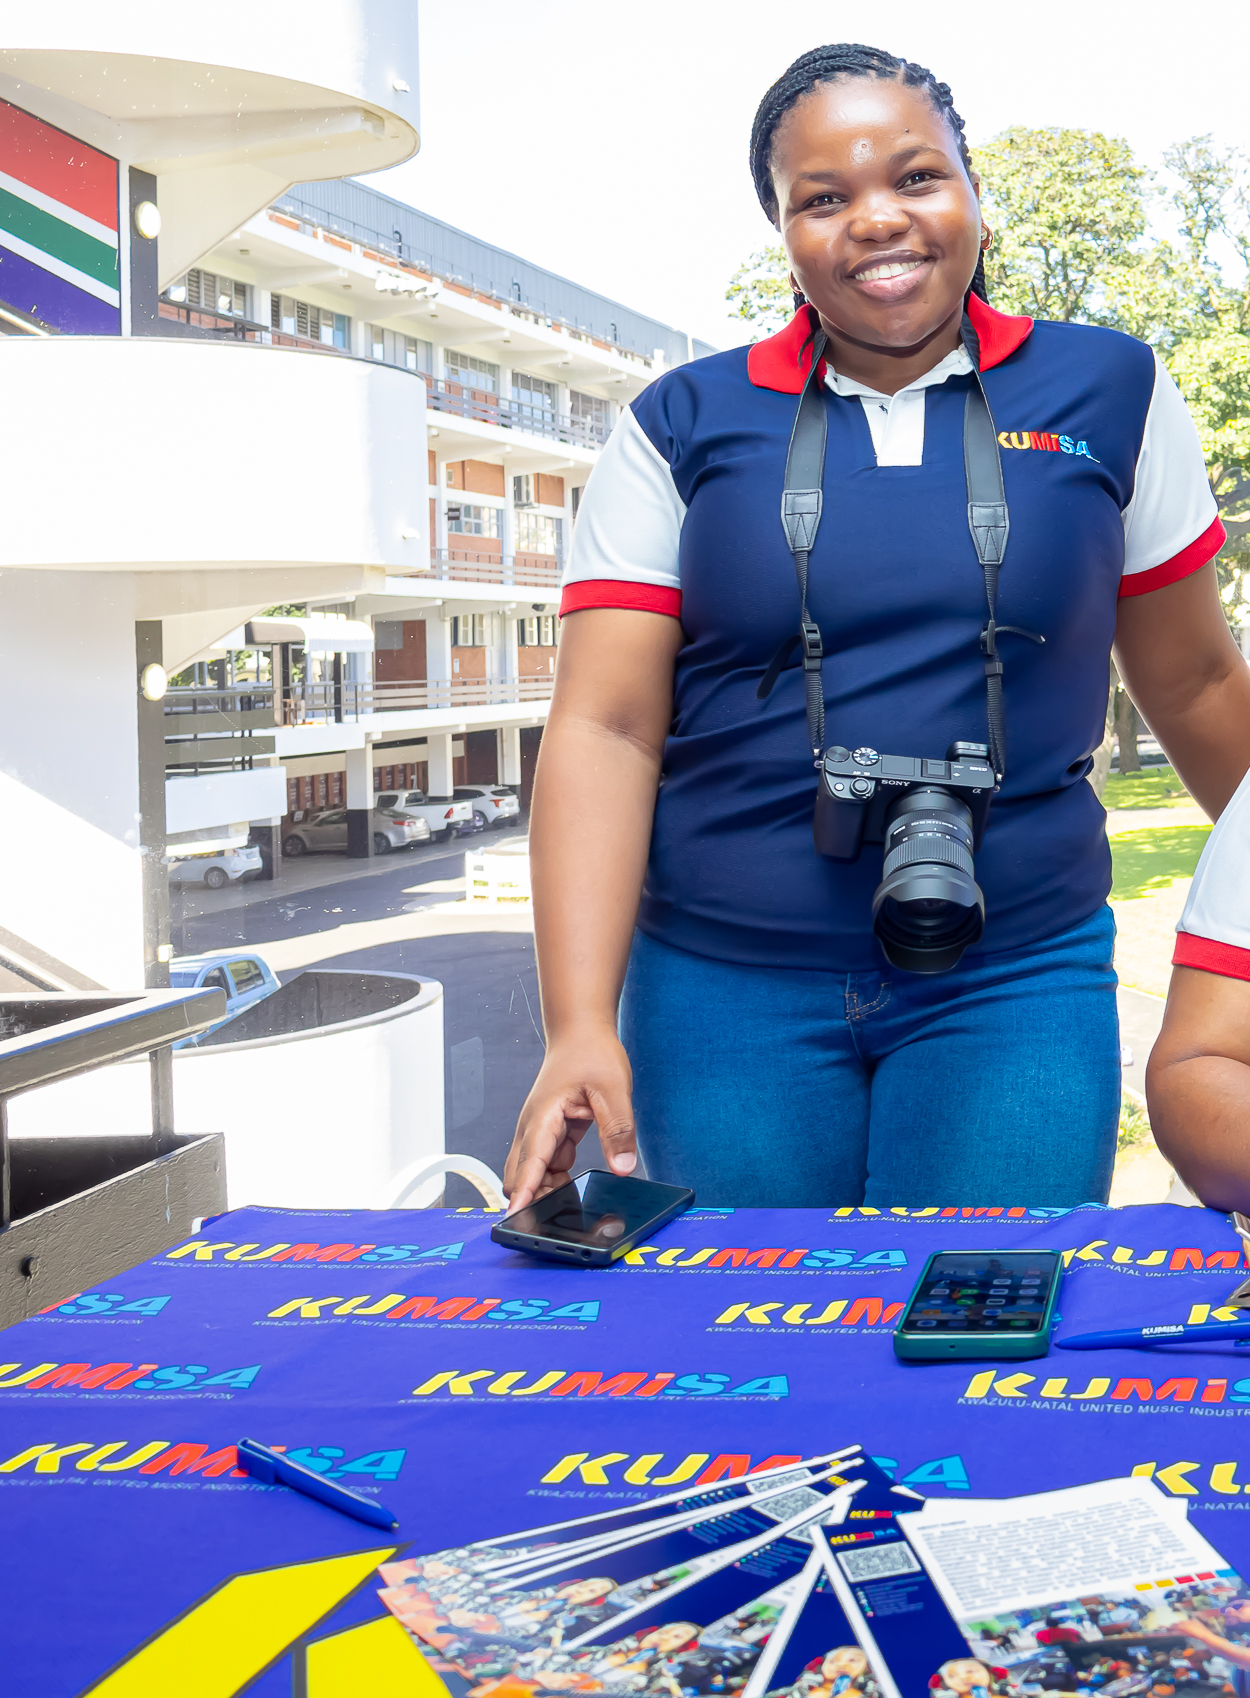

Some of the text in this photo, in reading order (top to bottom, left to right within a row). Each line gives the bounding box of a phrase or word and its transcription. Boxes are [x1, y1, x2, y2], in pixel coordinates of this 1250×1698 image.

[881, 779, 910, 787] SONY
[677, 1214, 728, 1222] OCIATION
[827, 1216, 914, 1225] KWAZULU-NATAL
[916, 1217, 957, 1225] UNITED
[996, 1218, 1051, 1226] INDUSTRY
[1061, 1240, 1250, 1270] KUM
[318, 1263, 373, 1271] INDUSTRY
[372, 1260, 449, 1271] ASSOCIATION
[679, 1267, 722, 1275] UNITED
[723, 1268, 761, 1276] MUSIC
[764, 1268, 823, 1277] INDUSTRY
[824, 1266, 904, 1277] ASSOCIATION
[1144, 1270, 1189, 1278] UNITED
[1192, 1268, 1231, 1276] MUSIC
[714, 1297, 906, 1326] KUM
[351, 1318, 397, 1329] UNITED
[399, 1322, 439, 1330] MUSIC
[440, 1322, 502, 1331] INDUSTRY
[503, 1323, 587, 1331] ASSOCIATION
[705, 1326, 895, 1335] KWAZULU-NATAL UNITED MUSI
[0, 1362, 262, 1391] UMiSA
[957, 1396, 1075, 1412] KWAZULU-NATAL
[1079, 1402, 1136, 1414] UNITED
[1138, 1403, 1185, 1414] MUSIC
[0, 1440, 407, 1482] KUMSA
[527, 1488, 649, 1500] KWAZULU-NATAL
